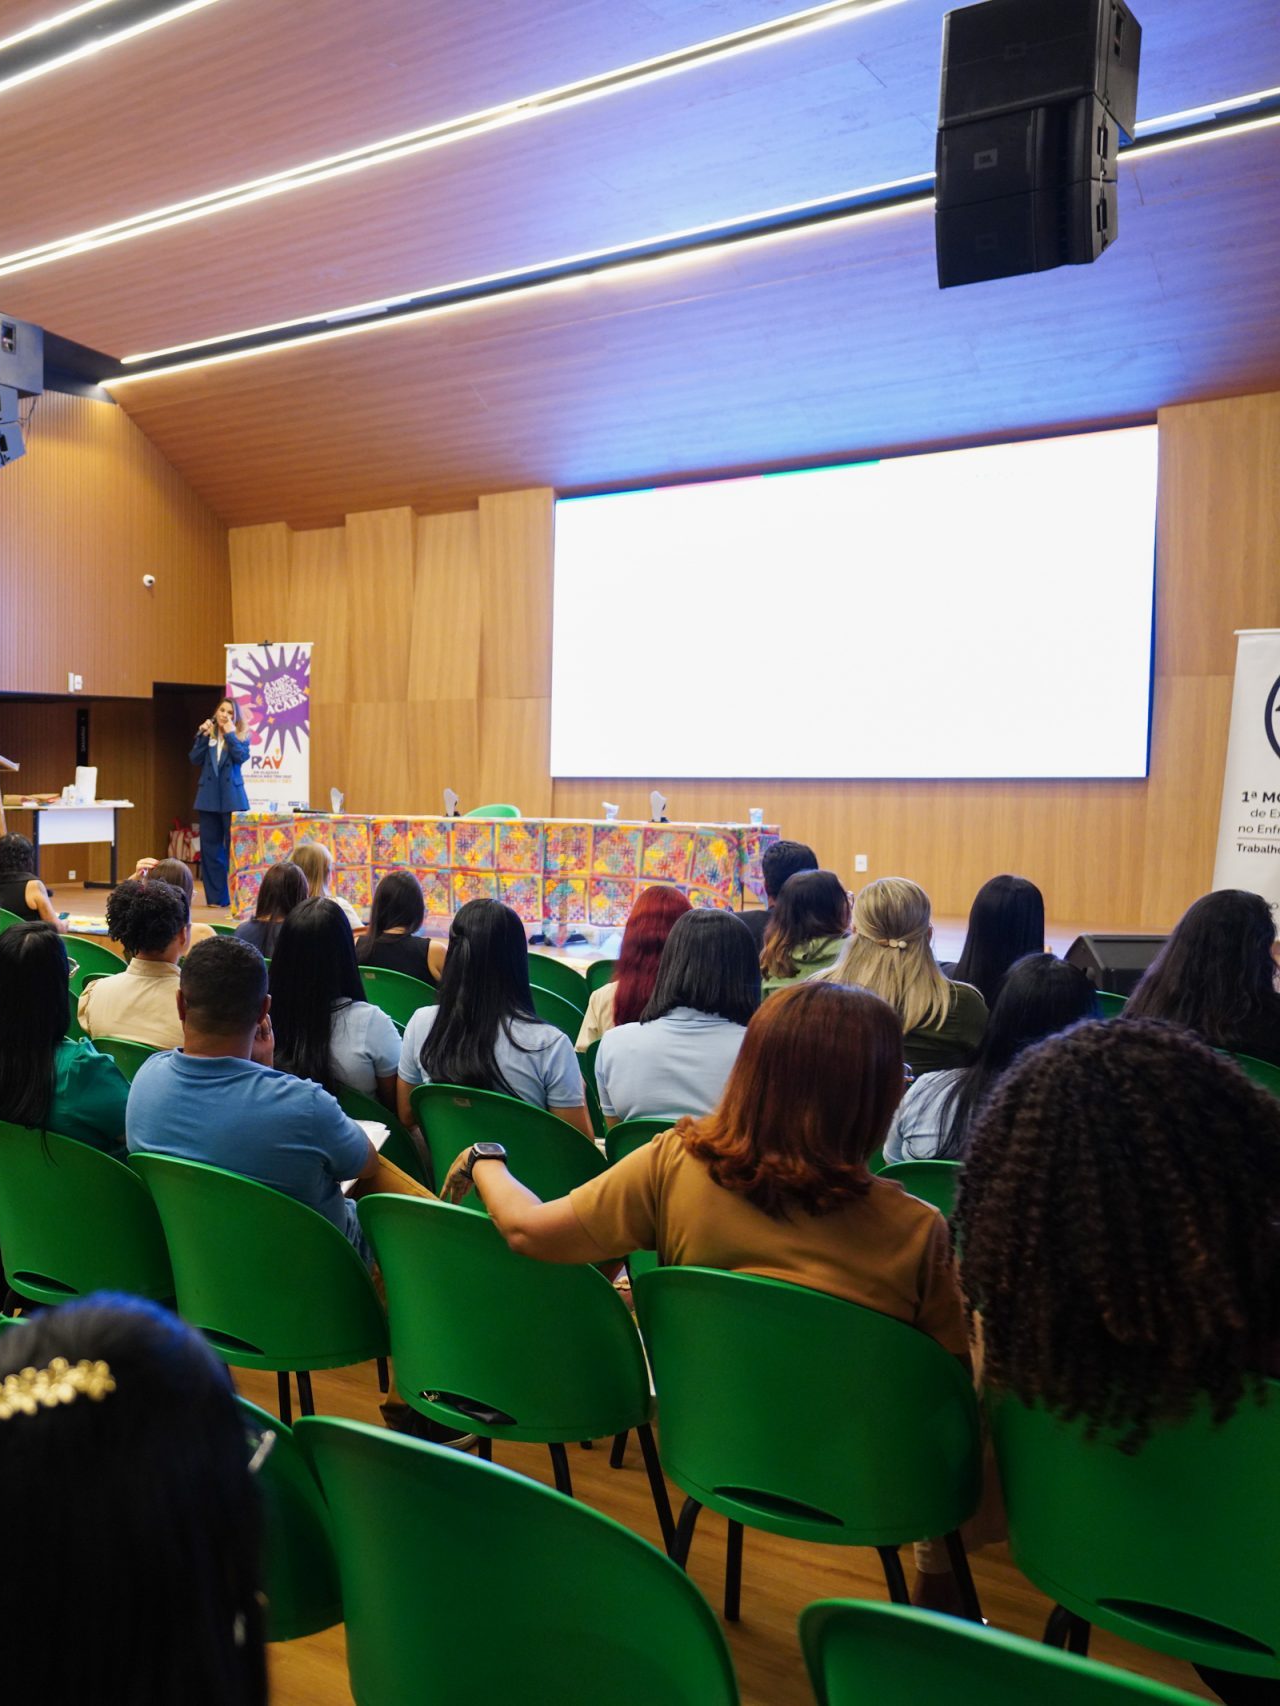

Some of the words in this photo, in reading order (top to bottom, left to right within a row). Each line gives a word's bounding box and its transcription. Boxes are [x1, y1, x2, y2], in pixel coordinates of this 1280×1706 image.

[266, 694, 308, 715] ACABA
[1241, 791, 1257, 803] 1ª
[1250, 808, 1266, 818] de
[1238, 825, 1254, 833] no
